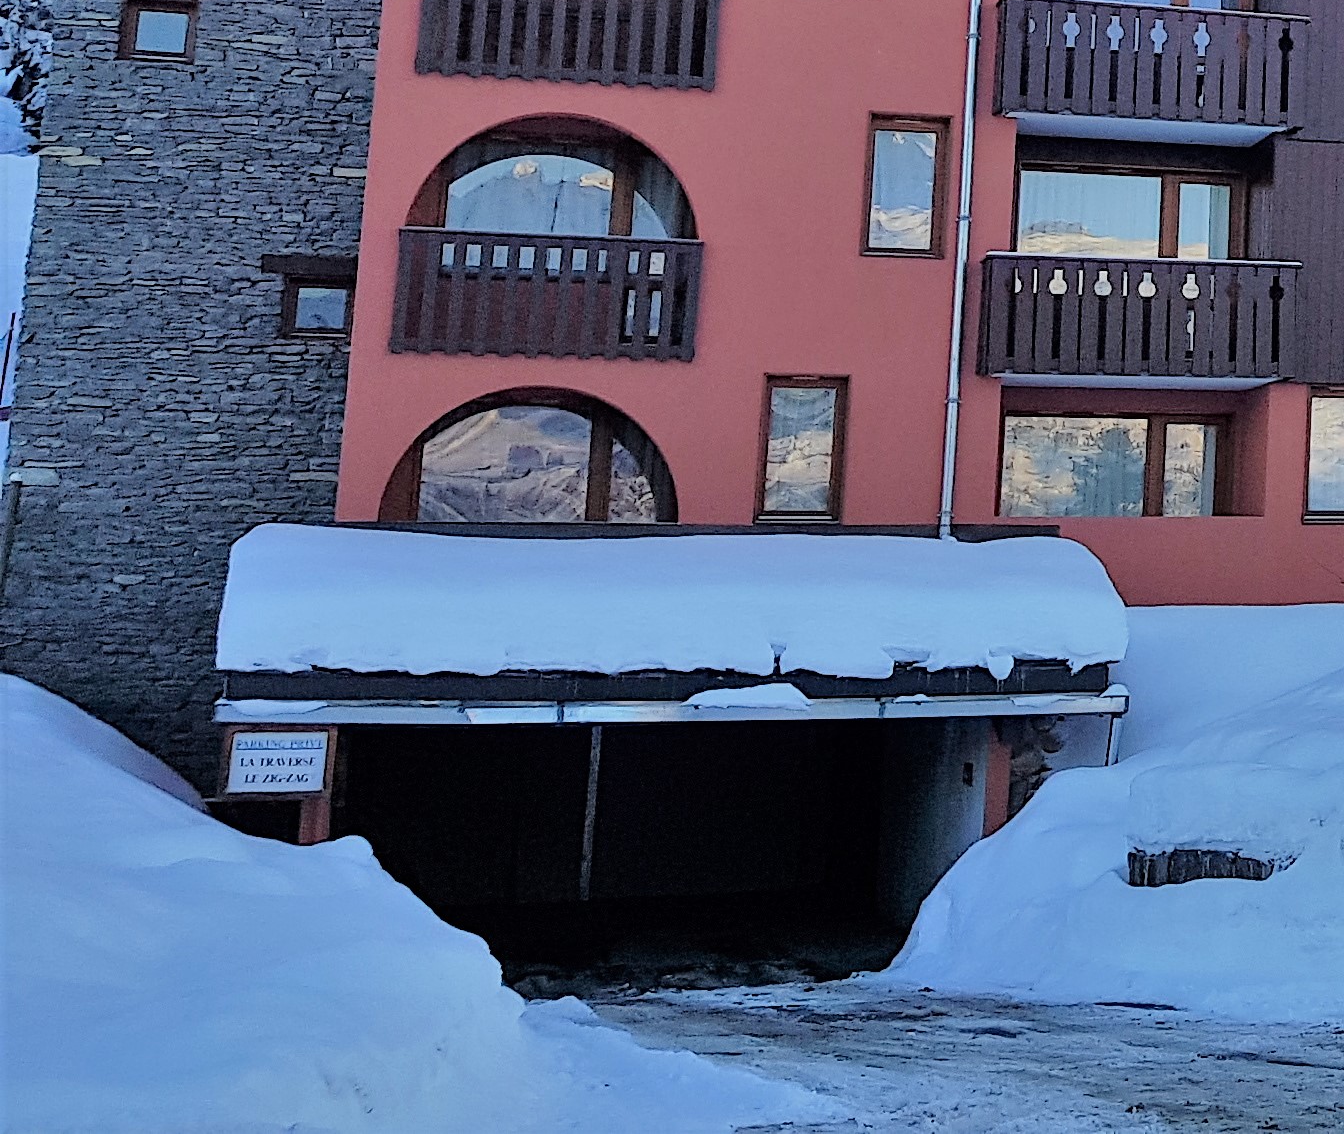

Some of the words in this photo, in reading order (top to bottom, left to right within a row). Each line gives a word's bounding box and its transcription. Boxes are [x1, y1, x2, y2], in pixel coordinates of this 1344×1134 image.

[240, 757, 255, 767] LA
[260, 756, 317, 767] TRAVERSE
[245, 773, 258, 784] LE
[262, 773, 309, 784] ZIG-ZAG
